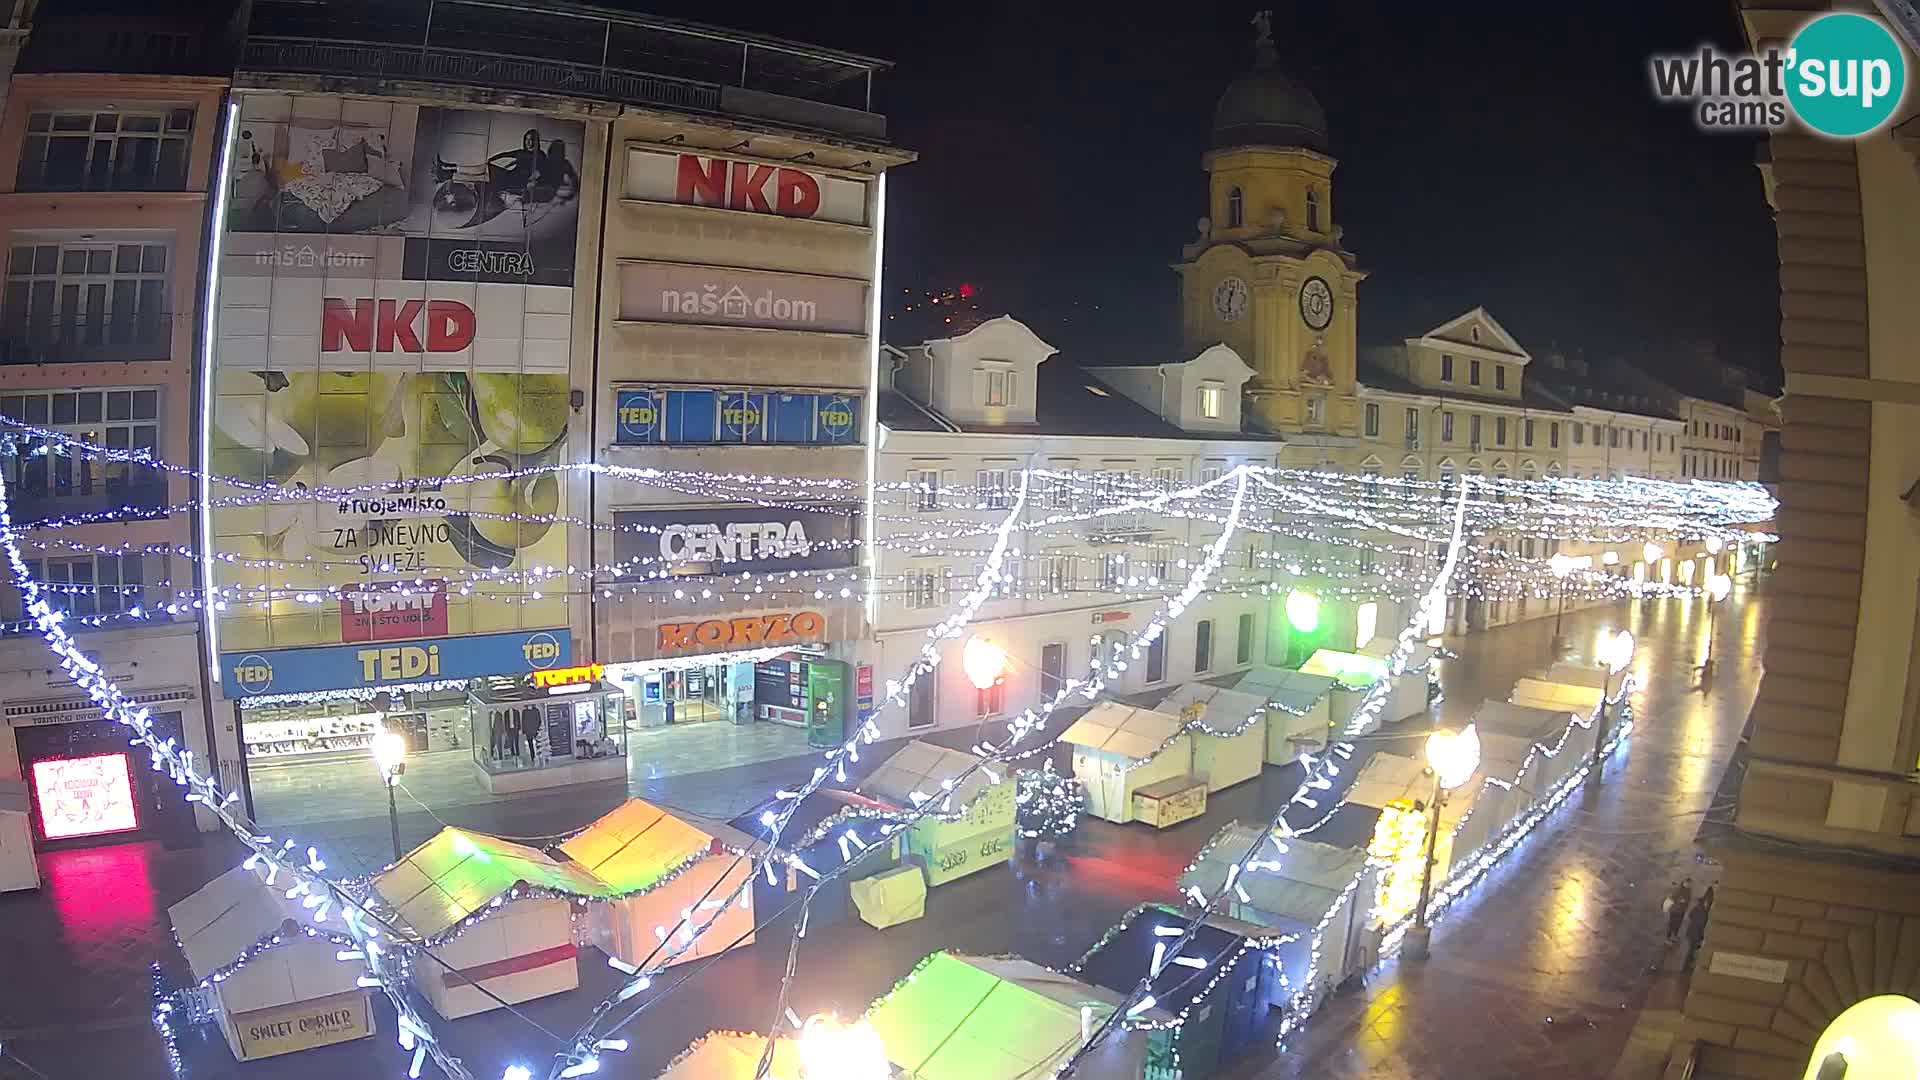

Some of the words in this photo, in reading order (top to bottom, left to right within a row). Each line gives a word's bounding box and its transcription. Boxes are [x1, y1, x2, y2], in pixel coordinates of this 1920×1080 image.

[676, 153, 820, 219] NKD
[448, 249, 535, 275] CENTRA
[661, 283, 718, 314] naš
[754, 289, 817, 322] dom
[321, 298, 476, 353] NKD
[619, 409, 657, 424] TEDi
[723, 409, 760, 425] TEDi
[819, 410, 854, 425] TEDi
[333, 528, 358, 548] ZA
[366, 523, 450, 548] DNEVNO
[659, 520, 810, 562] CENTRA
[360, 547, 425, 575] SVJEŽE
[658, 611, 825, 650] KORZO
[358, 645, 440, 682] TEDi
[523, 643, 560, 660] TEDi
[234, 665, 273, 684] TEDi
[533, 663, 605, 689] TOMMY
[249, 1021, 293, 1040] SWEET
